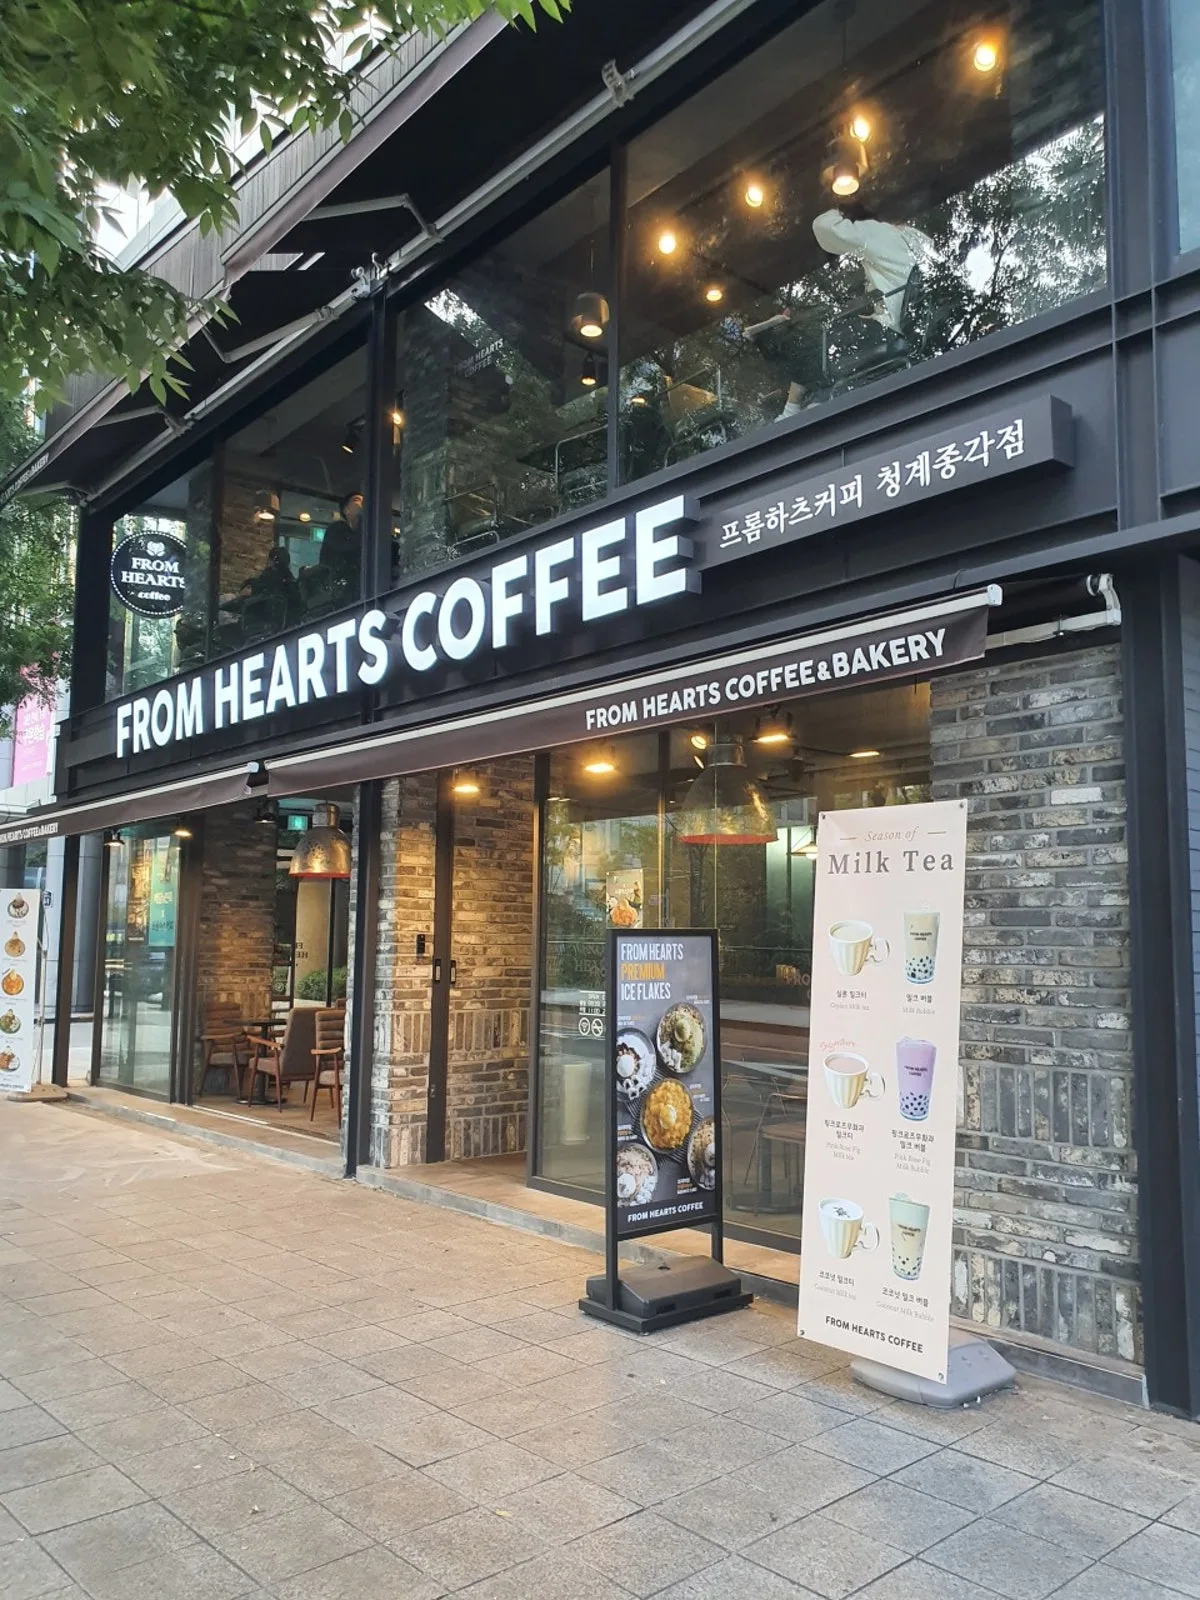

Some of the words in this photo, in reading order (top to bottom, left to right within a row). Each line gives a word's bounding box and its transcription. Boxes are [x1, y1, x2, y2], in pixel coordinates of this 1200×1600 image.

[719, 474, 863, 549] 프롬하츠커피
[876, 418, 1025, 498] 청계종각점
[131, 556, 180, 574] FROM
[120, 570, 186, 589] HEARTS
[137, 590, 171, 602] coffee
[117, 677, 204, 758] FROM
[215, 609, 389, 731] HEARTS
[400, 494, 687, 672] COFFEE
[585, 703, 638, 730] FROM
[642, 681, 721, 717] HEARTS
[864, 830, 901, 841] Season
[904, 825, 920, 842] of
[827, 850, 890, 875] Milk
[902, 850, 954, 872] Tea
[620, 943, 648, 961] FROM
[649, 943, 684, 961] HEARTS
[620, 962, 665, 981] PREMIUM
[620, 983, 636, 1001] ICE
[637, 982, 671, 1000] FLAKES
[627, 1211, 648, 1223] FROM
[649, 1205, 677, 1219] HEARTS
[677, 1201, 704, 1214] COFFEE
[825, 1315, 850, 1331] FROM
[851, 1325, 886, 1342] HEARTS
[887, 1334, 924, 1353] COFFEE
